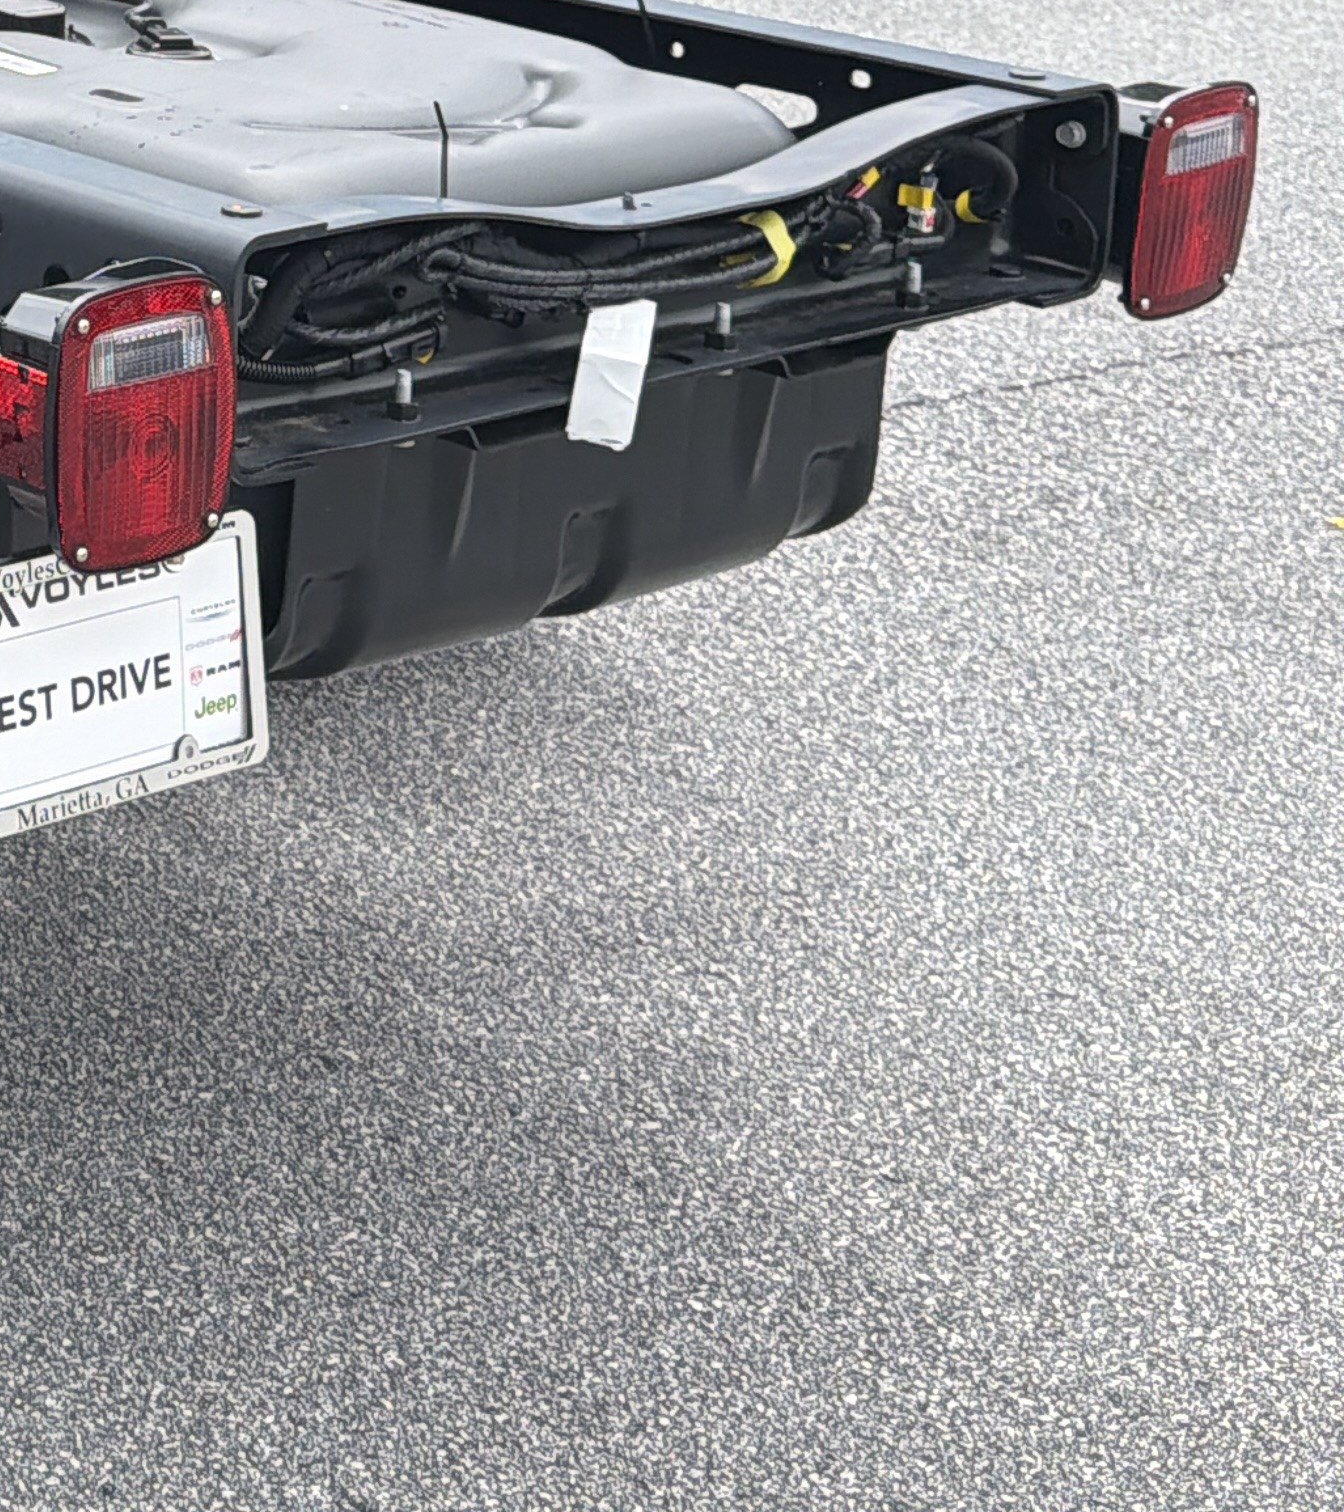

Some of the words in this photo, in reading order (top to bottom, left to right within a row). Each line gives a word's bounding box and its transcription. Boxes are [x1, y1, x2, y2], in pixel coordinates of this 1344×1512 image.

[206, 660, 241, 676] RAM
[71, 653, 172, 713] DRIVE
[194, 693, 237, 719] Jeep
[167, 750, 246, 779] DODGE
[18, 787, 110, 830] Marietta,
[115, 774, 149, 801] GA
